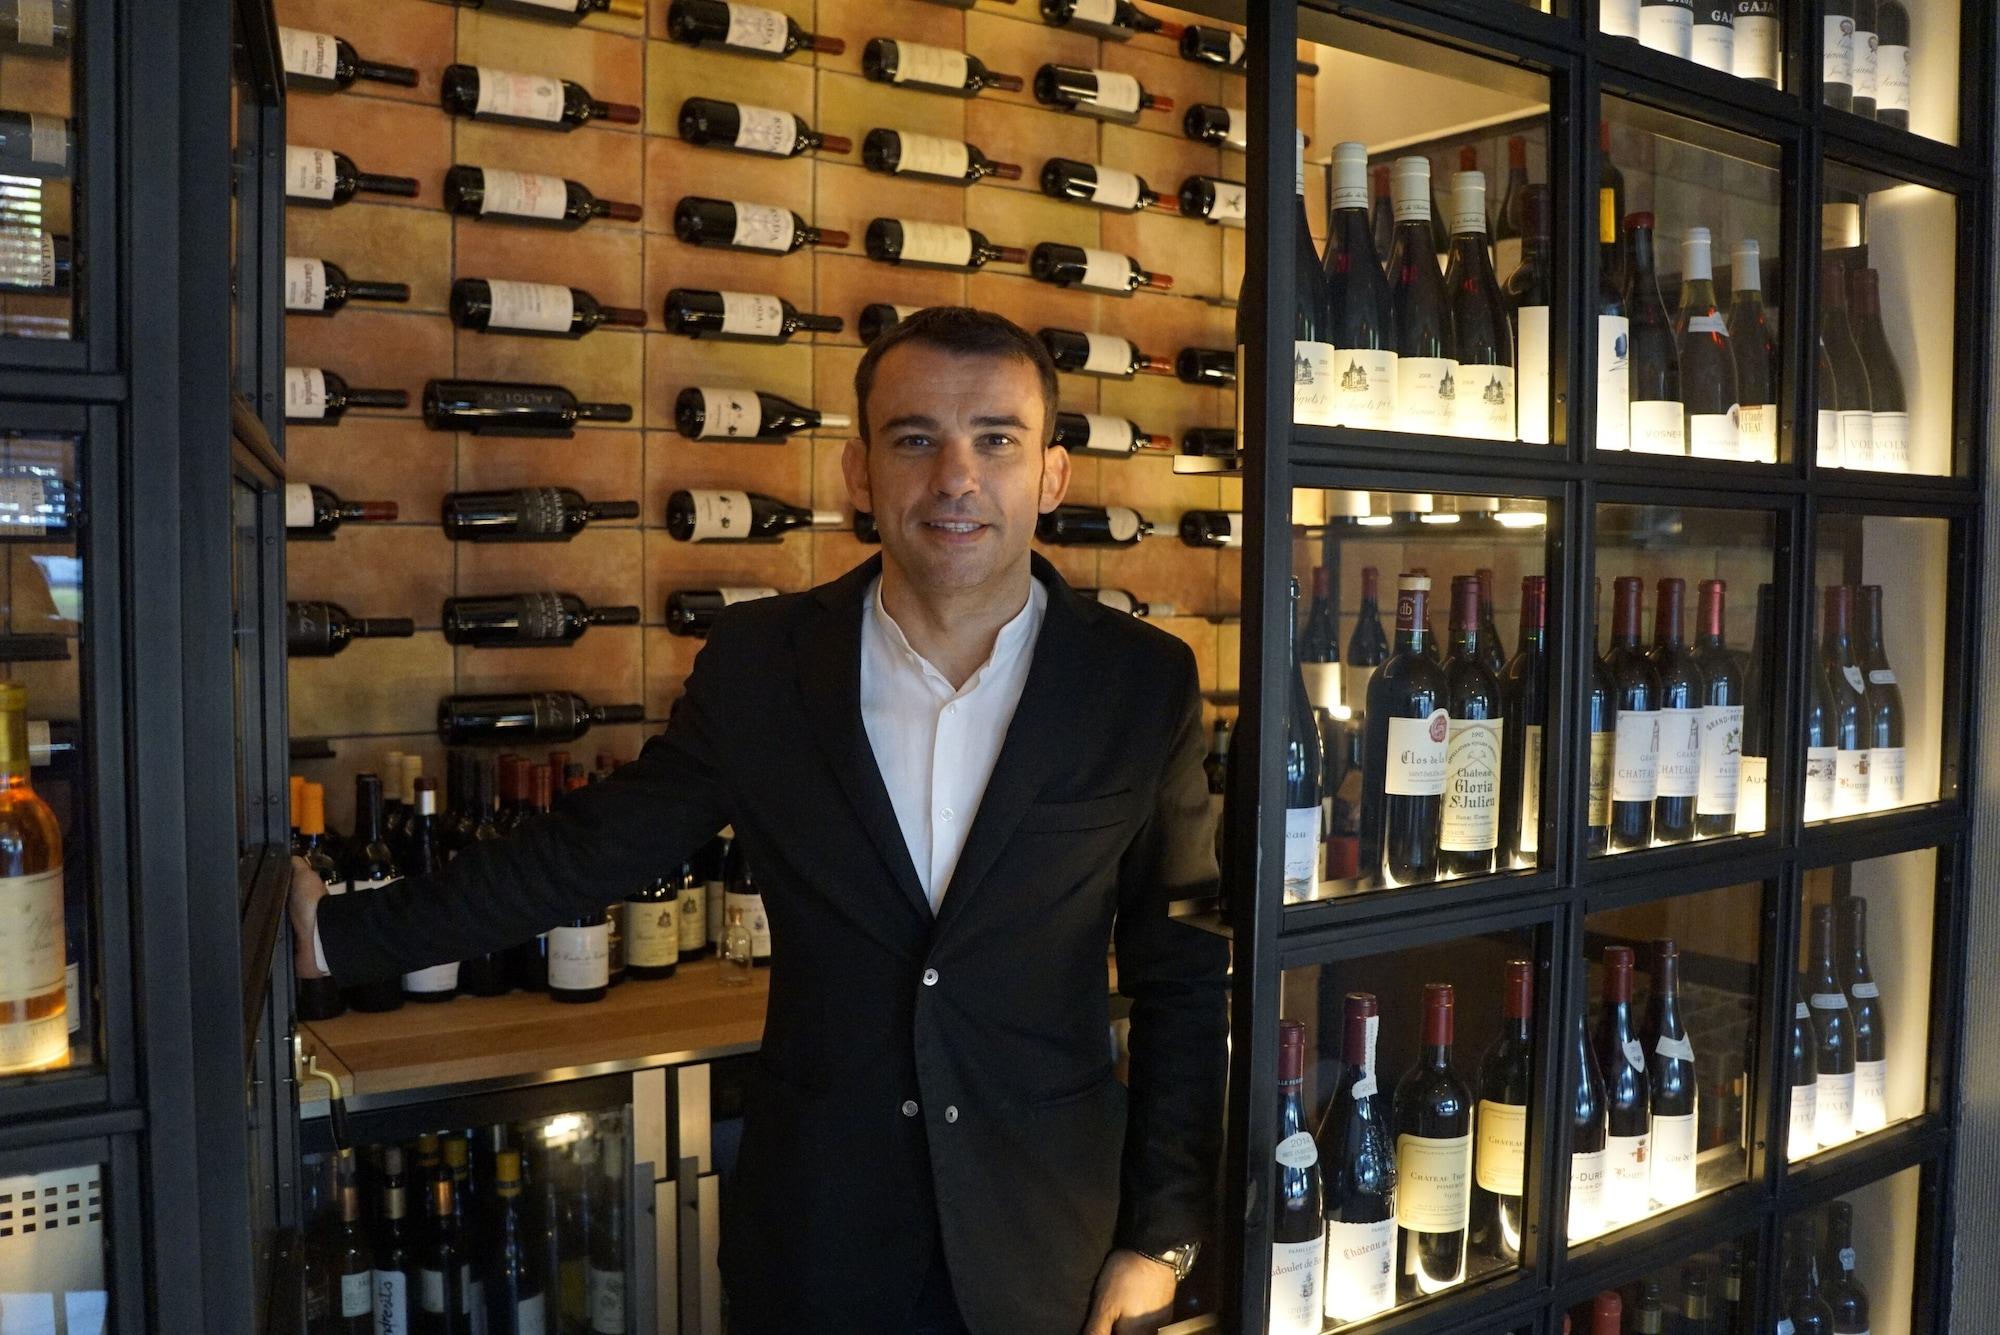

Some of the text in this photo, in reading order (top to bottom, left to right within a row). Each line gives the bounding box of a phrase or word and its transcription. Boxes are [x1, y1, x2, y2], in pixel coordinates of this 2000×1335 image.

[1737, 1, 1776, 14] GAJA
[1401, 750, 1428, 765] Clos
[1455, 778, 1494, 795] Gloria
